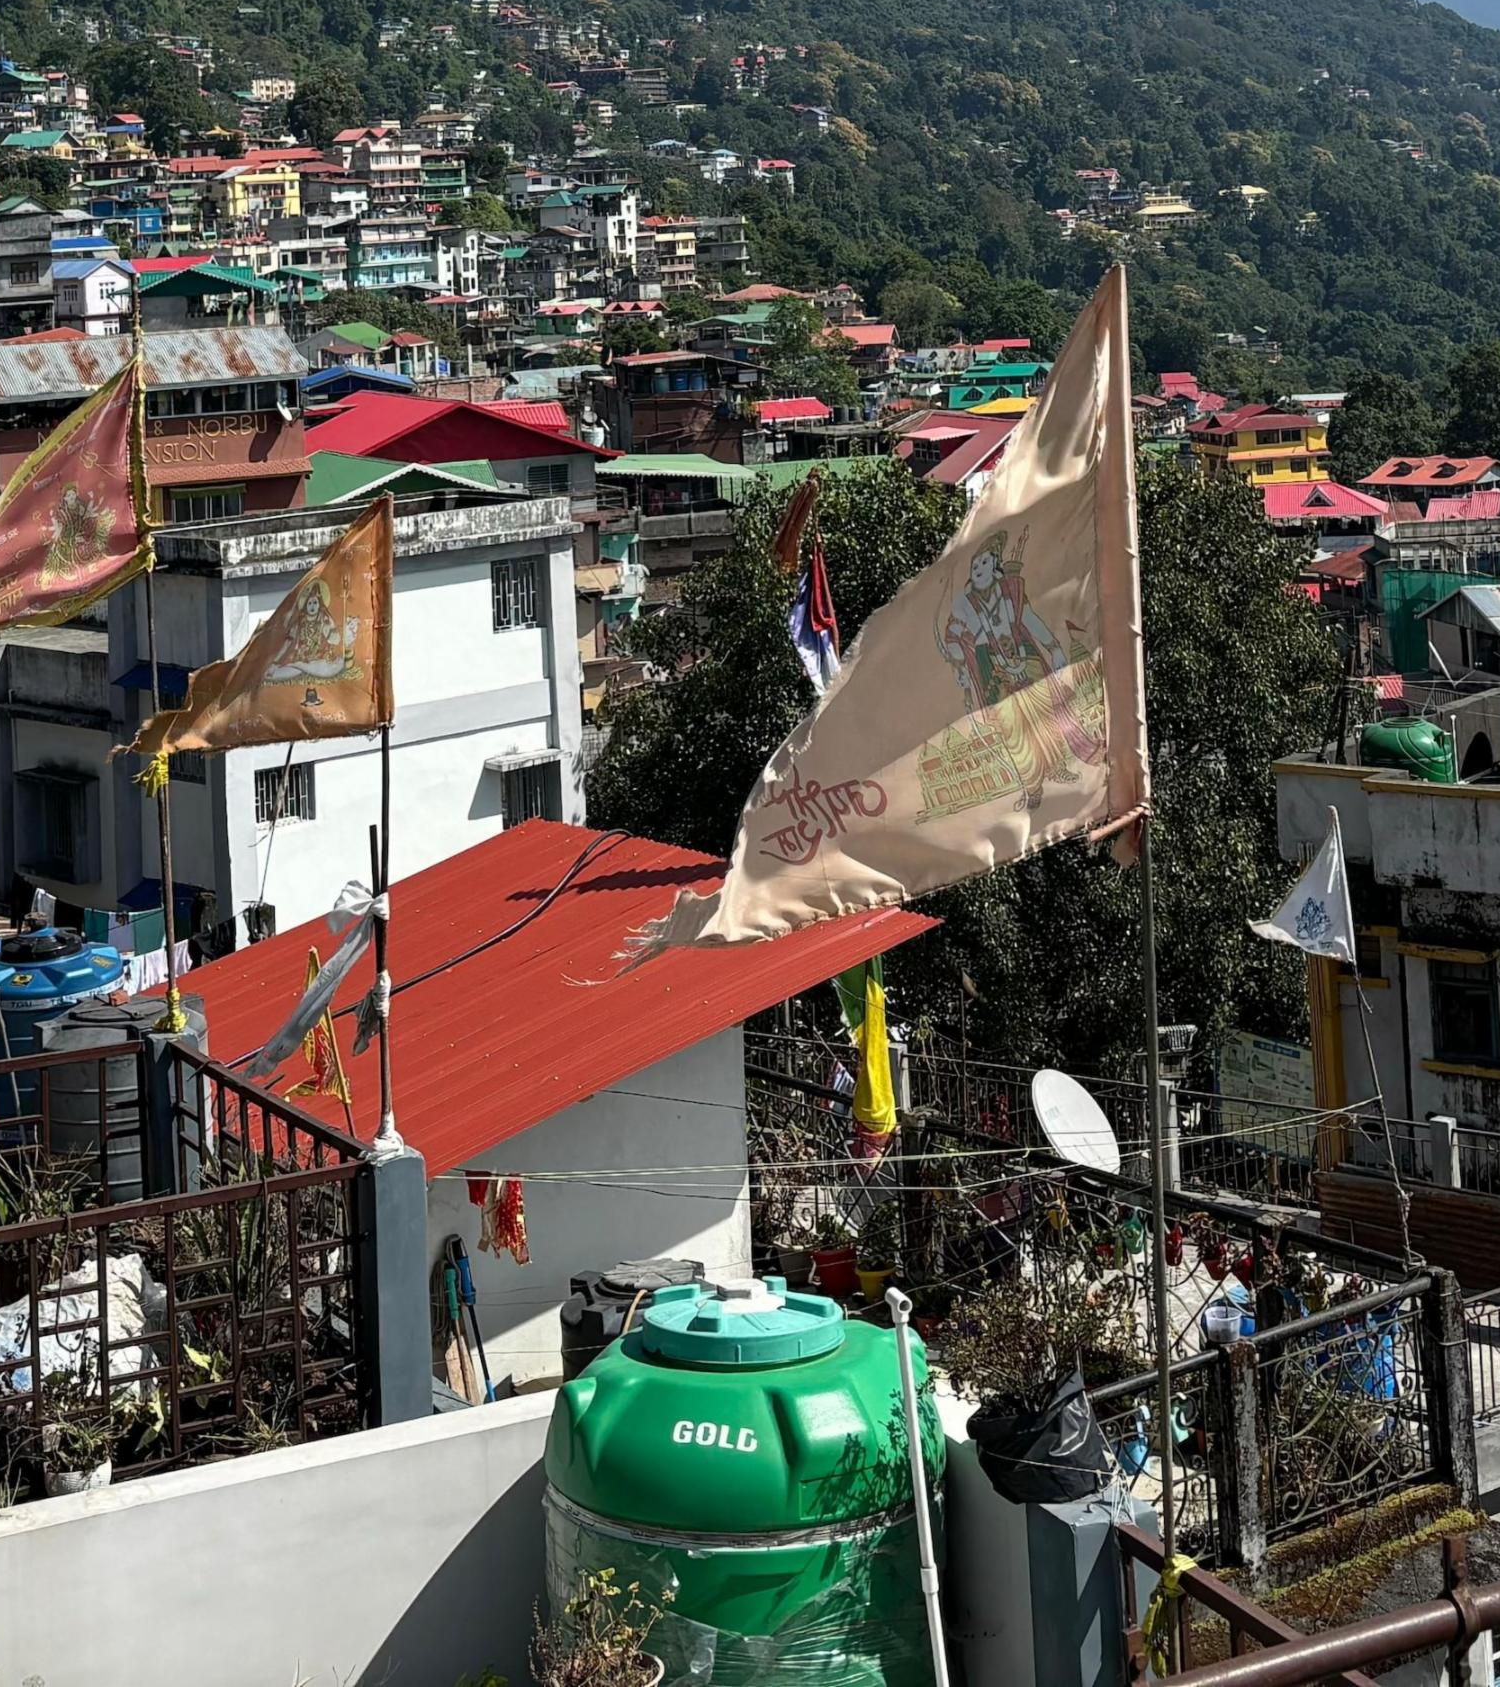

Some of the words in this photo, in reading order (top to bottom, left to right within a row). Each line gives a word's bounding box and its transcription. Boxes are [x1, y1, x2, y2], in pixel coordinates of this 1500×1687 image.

[154, 419, 164, 436] &
[185, 414, 268, 440] NORBU
[146, 440, 217, 462] NSION
[672, 1420, 758, 1452] GOLD
